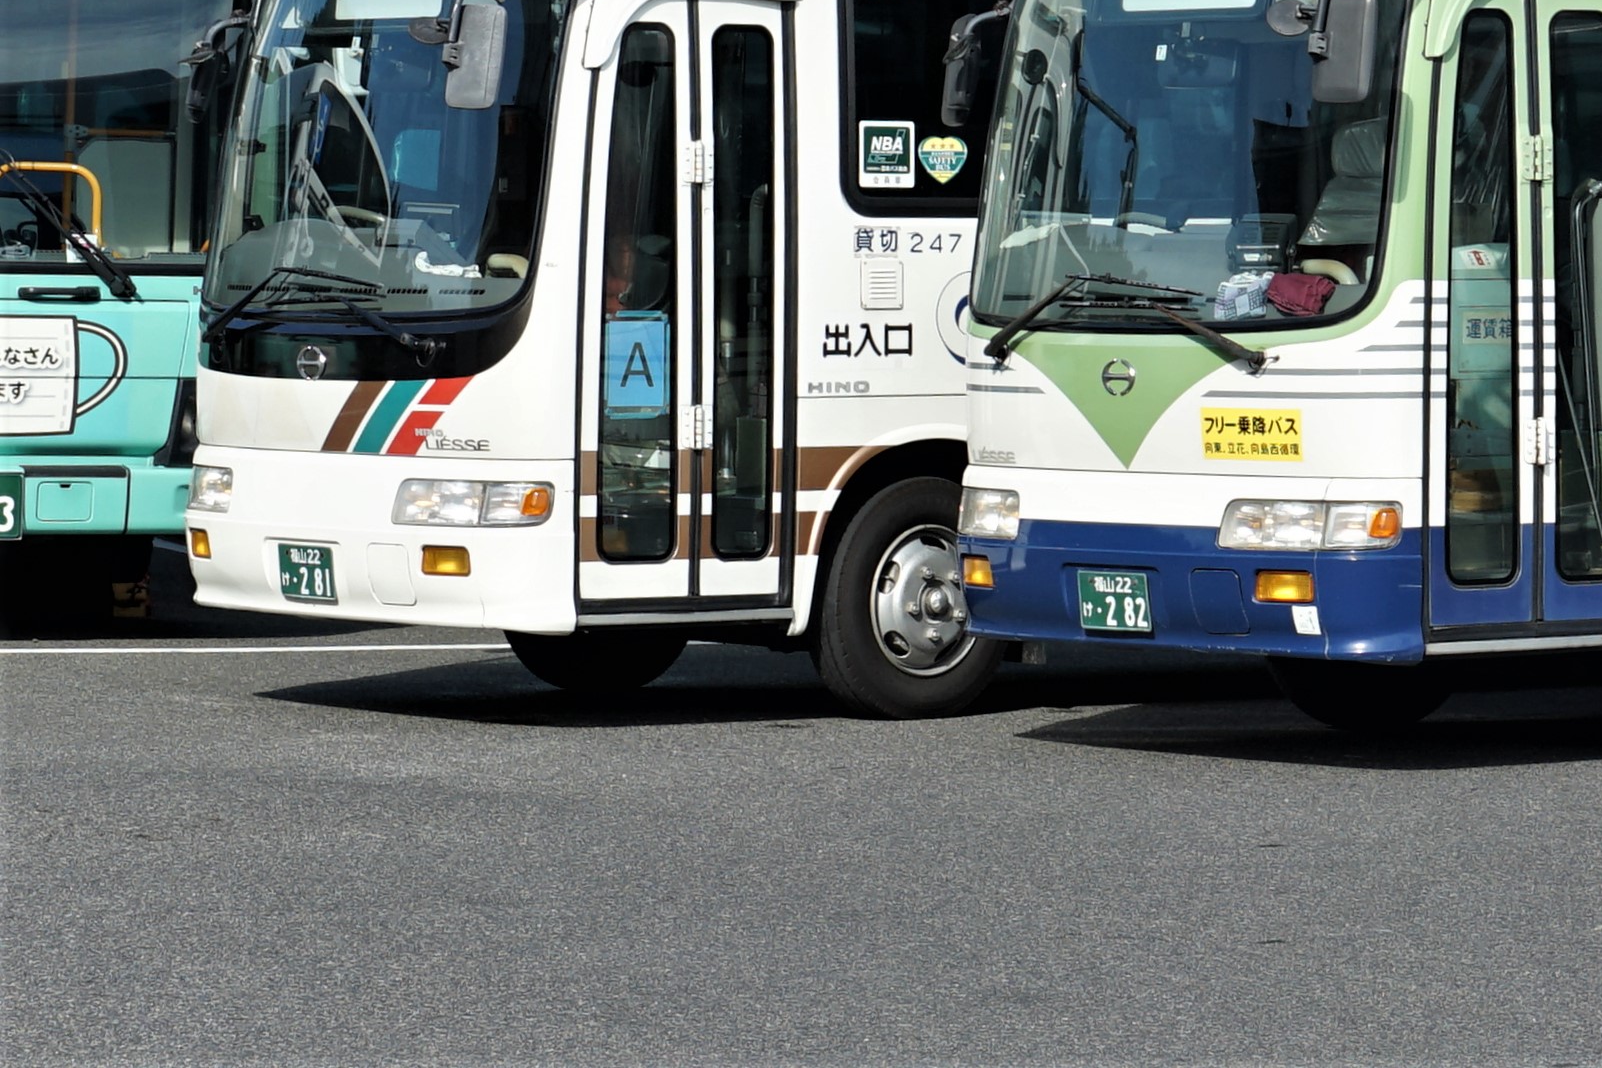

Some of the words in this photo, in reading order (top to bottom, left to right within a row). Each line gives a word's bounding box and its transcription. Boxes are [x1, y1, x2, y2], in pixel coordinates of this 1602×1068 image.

[870, 136, 904, 151] NBA
[855, 229, 899, 252] 貸切
[910, 234, 962, 253] 247
[823, 323, 913, 358] 出入口
[0, 347, 59, 365] なさん
[620, 342, 655, 387] A
[808, 381, 870, 394] HINO
[1204, 416, 1298, 435] フリー乗降バス
